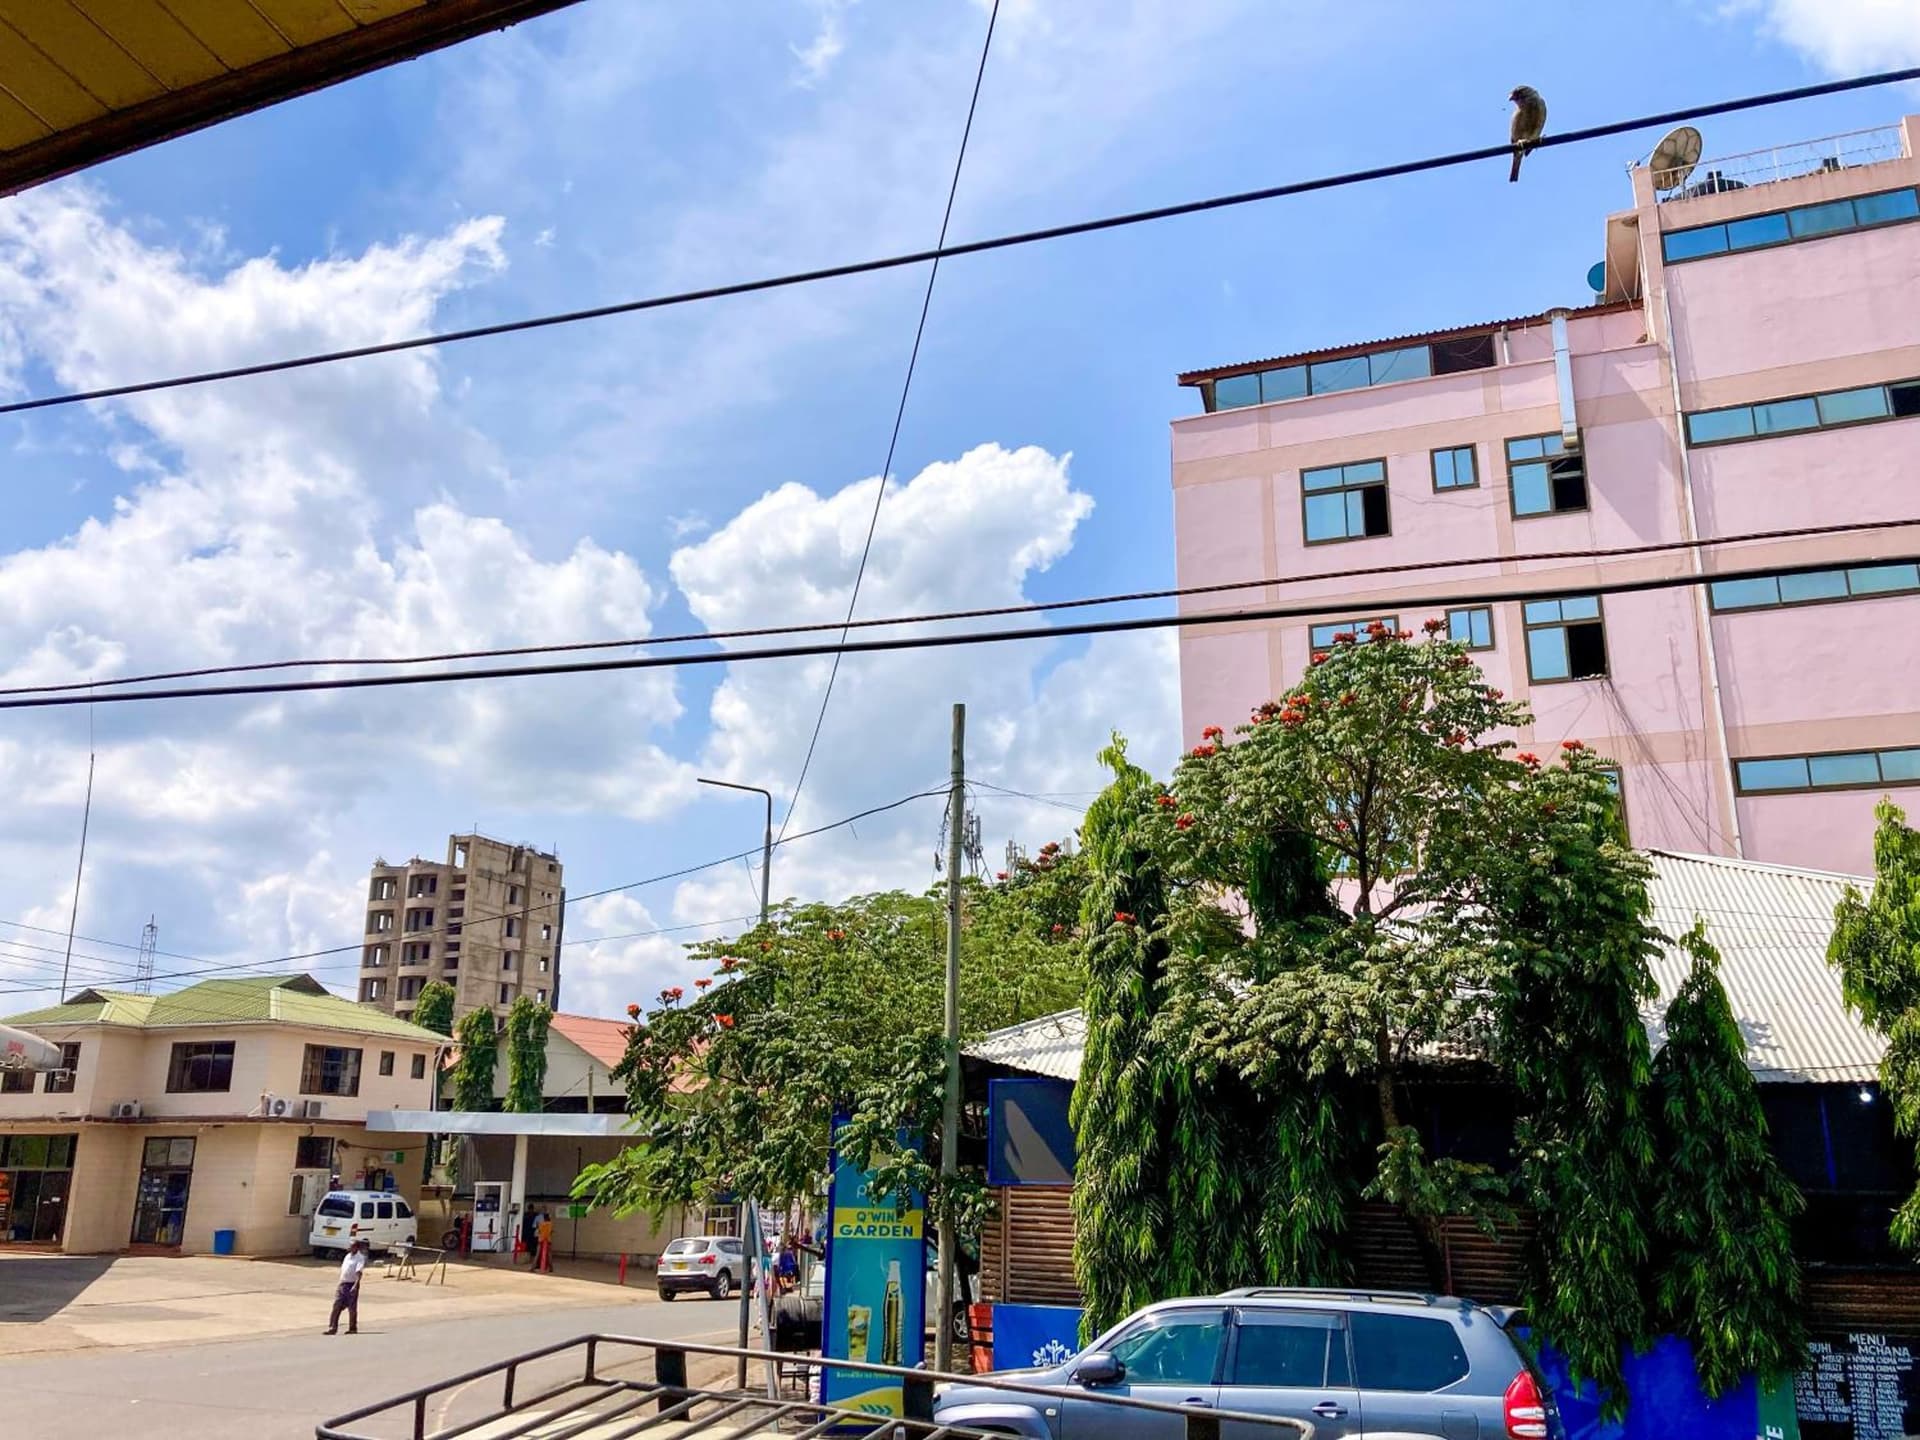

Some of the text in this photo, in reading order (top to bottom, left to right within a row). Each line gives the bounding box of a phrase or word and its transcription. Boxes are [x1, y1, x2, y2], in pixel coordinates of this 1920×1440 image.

[839, 1224, 913, 1237] GARDEN
[1848, 1333, 1886, 1346] MENU
[1857, 1345, 1911, 1357] MCHANA
